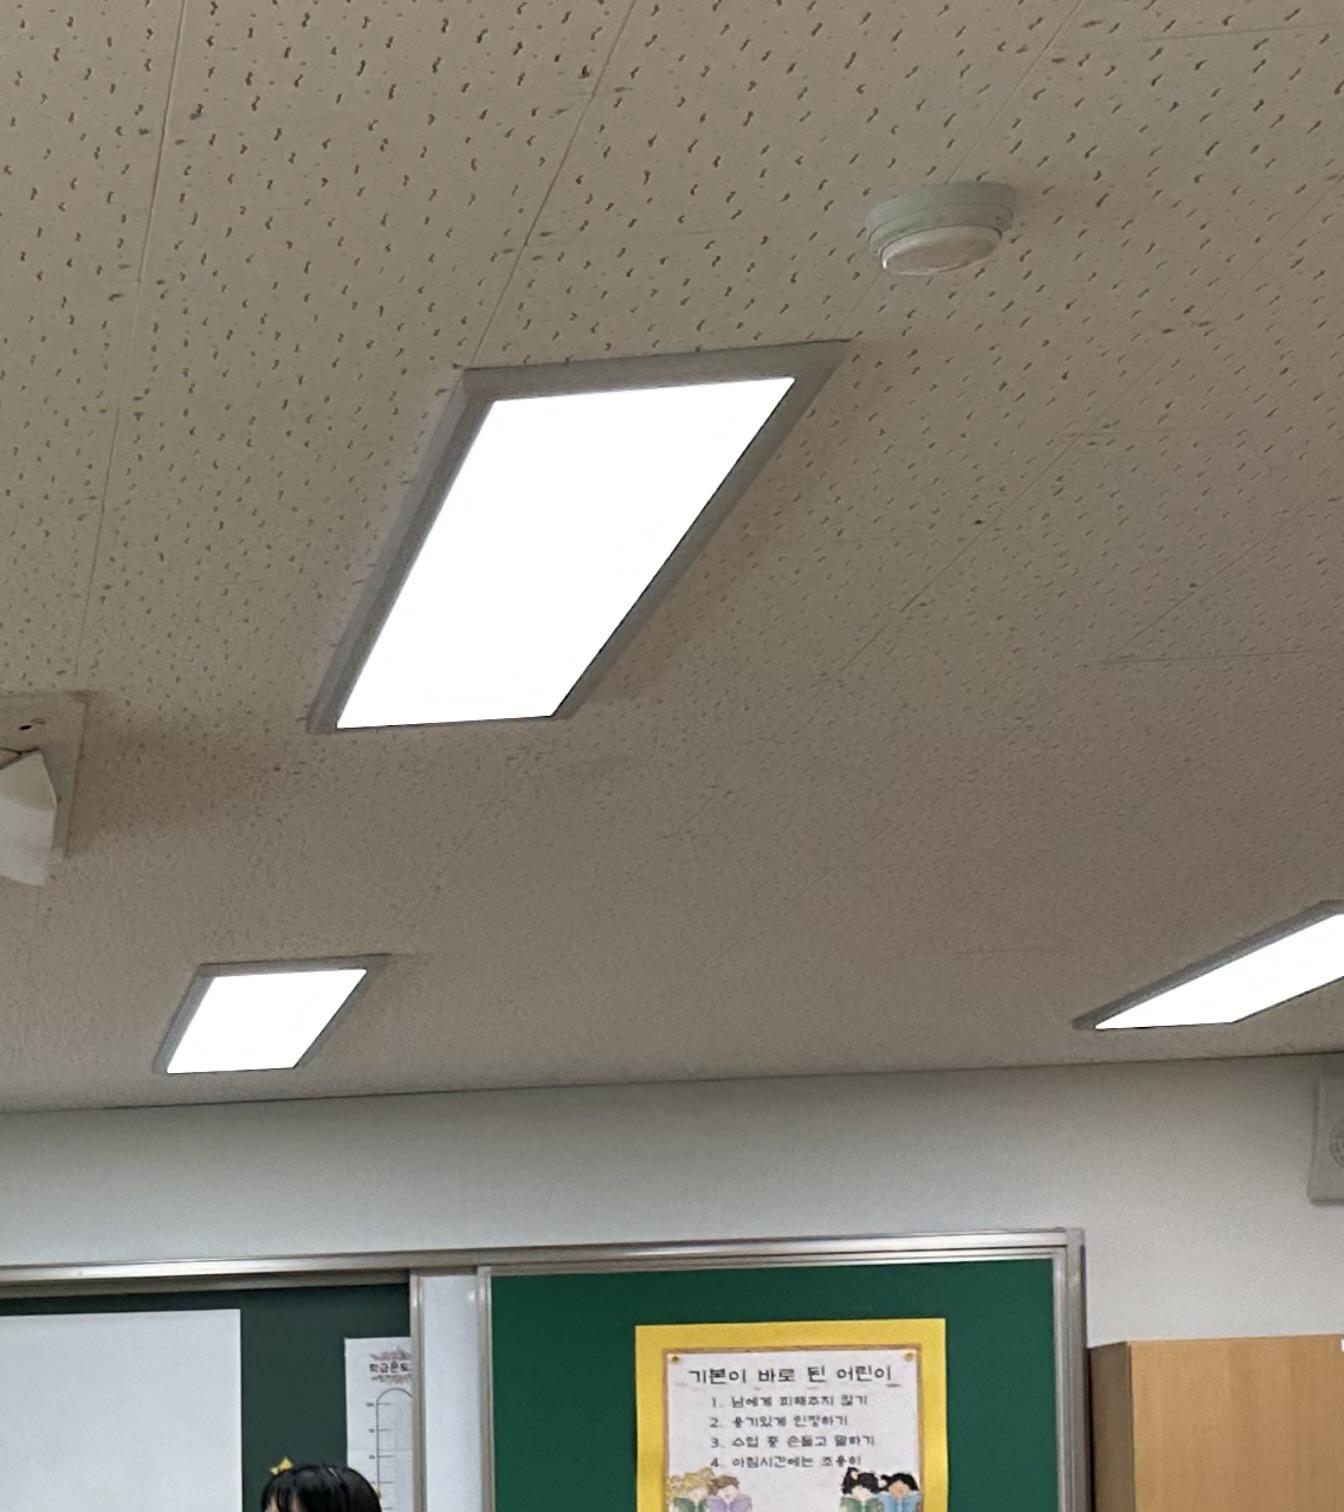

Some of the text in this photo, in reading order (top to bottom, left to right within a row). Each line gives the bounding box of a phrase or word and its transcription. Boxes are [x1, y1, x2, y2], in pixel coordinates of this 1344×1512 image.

[689, 1365, 892, 1385] 기본이 바로 된 어린이
[731, 1396, 773, 1408] 남에게
[779, 1395, 834, 1407] 피해주지
[732, 1416, 787, 1428] 용기있게
[794, 1415, 848, 1428] 인정하기
[732, 1436, 759, 1448] 수업
[787, 1435, 827, 1448] 손들고
[834, 1434, 875, 1447] 말하기
[821, 1455, 861, 1467] 조용히
